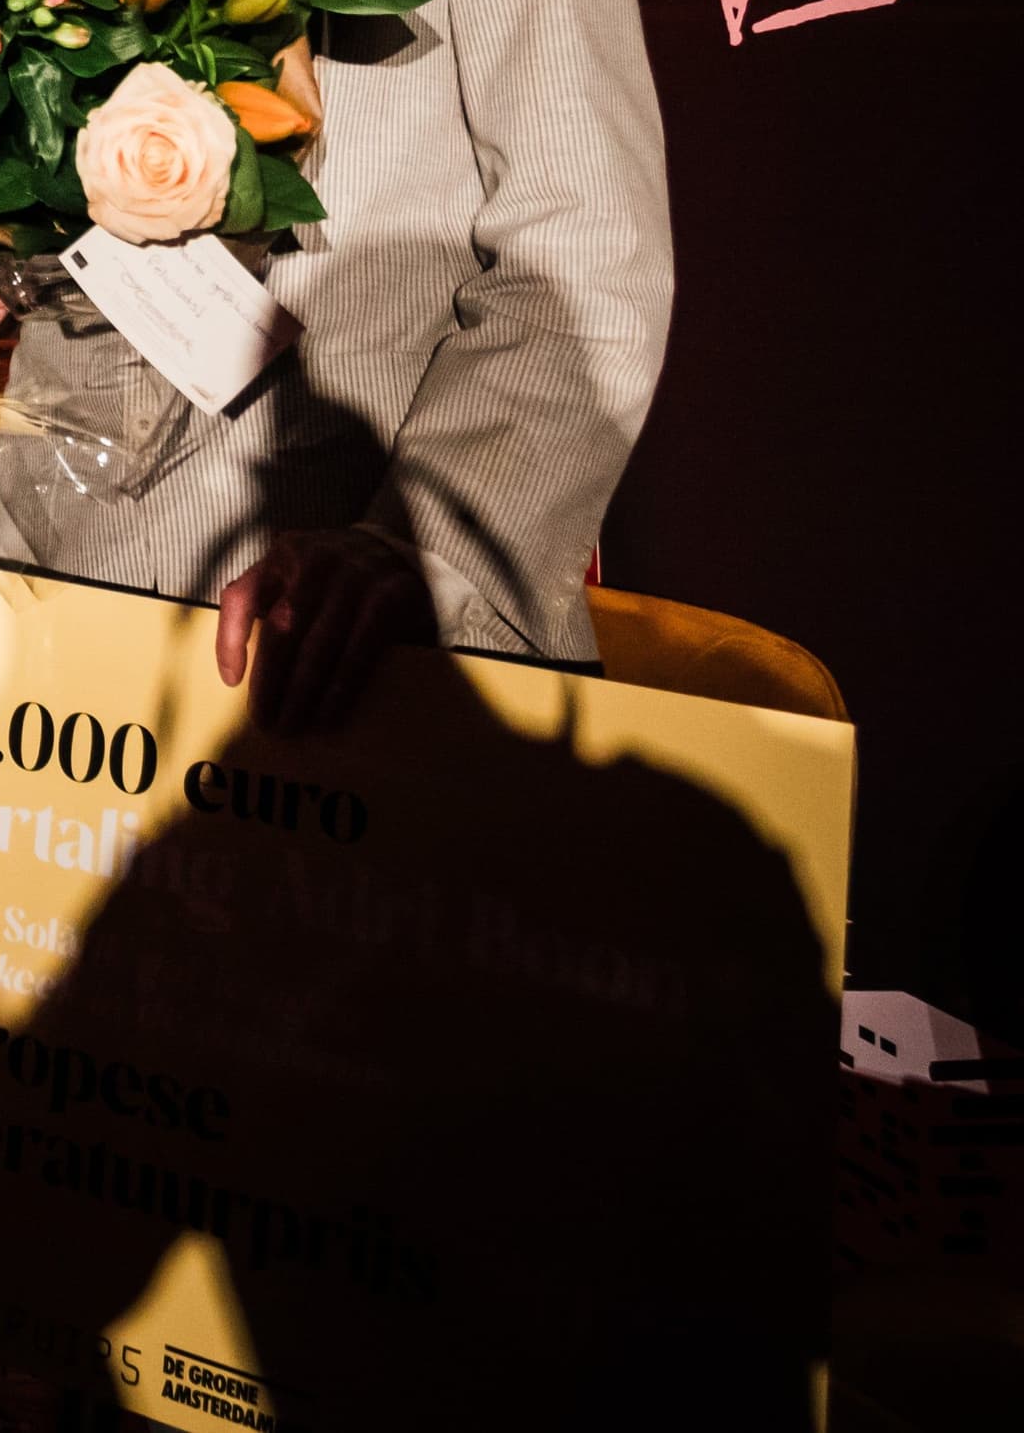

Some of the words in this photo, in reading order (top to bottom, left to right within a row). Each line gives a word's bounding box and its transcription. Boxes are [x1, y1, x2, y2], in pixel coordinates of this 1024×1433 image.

[184, 761, 368, 844] euro
[161, 1379, 282, 1433] AMSTERDAM
[163, 1354, 184, 1379] DE
[187, 1365, 259, 1406] GROENE
